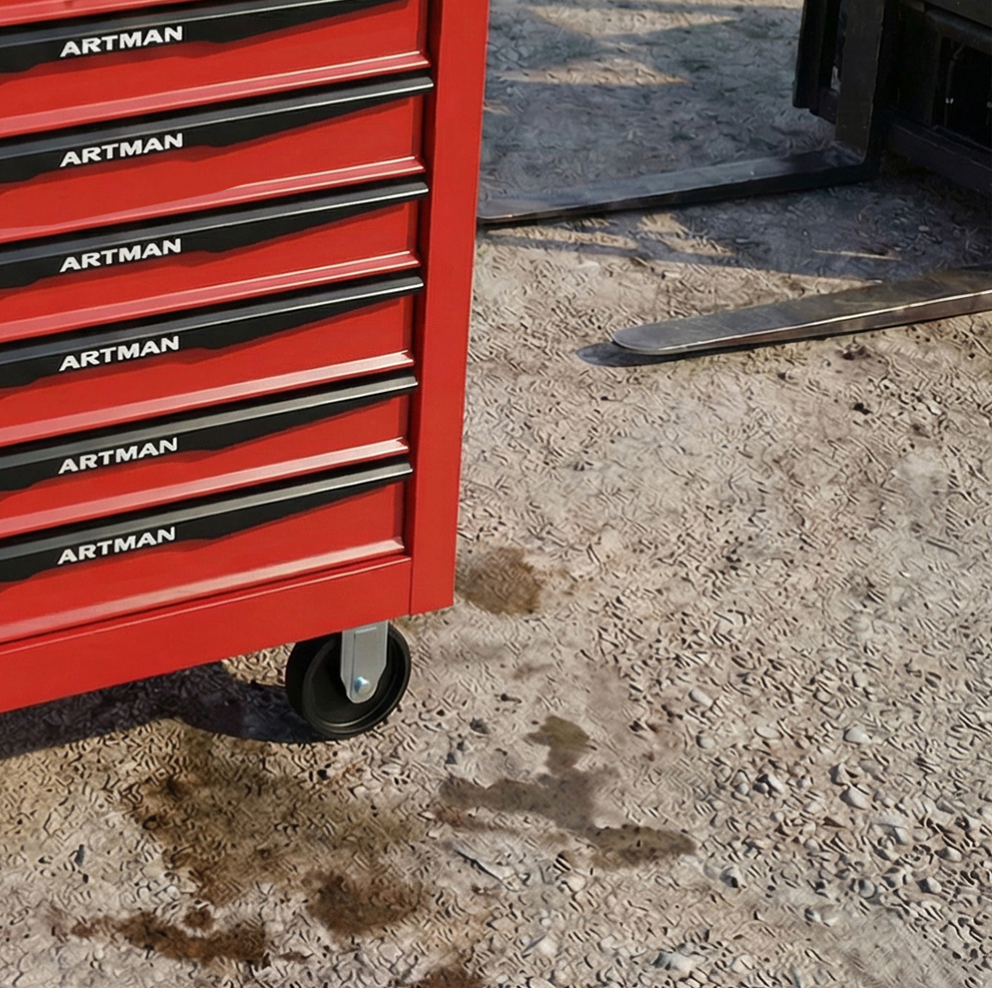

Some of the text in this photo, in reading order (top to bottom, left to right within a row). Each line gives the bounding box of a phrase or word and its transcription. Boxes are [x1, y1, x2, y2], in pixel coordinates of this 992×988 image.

[60, 25, 183, 58] ARTMAN
[59, 132, 183, 168] ARTMAN
[59, 238, 181, 273] ARTMAN
[59, 335, 179, 372] ARTMAN
[58, 437, 178, 475] ARTMAN
[57, 526, 176, 565] ARTMAN
